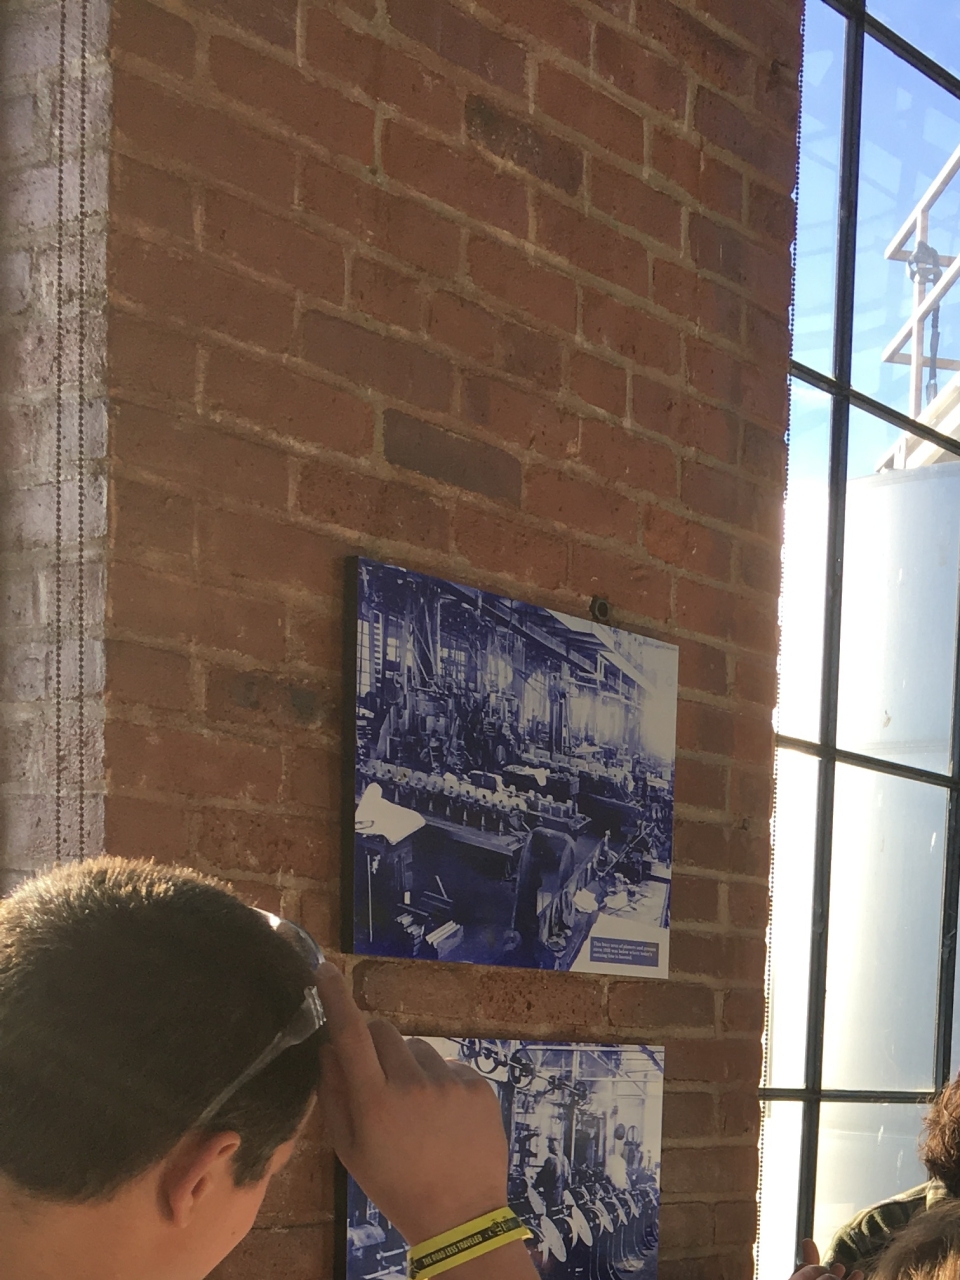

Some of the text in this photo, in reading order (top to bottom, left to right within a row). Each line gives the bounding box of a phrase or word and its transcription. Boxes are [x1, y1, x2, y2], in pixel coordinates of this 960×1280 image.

[423, 1234, 483, 1266] THE ROAD LESS TRAVELED
